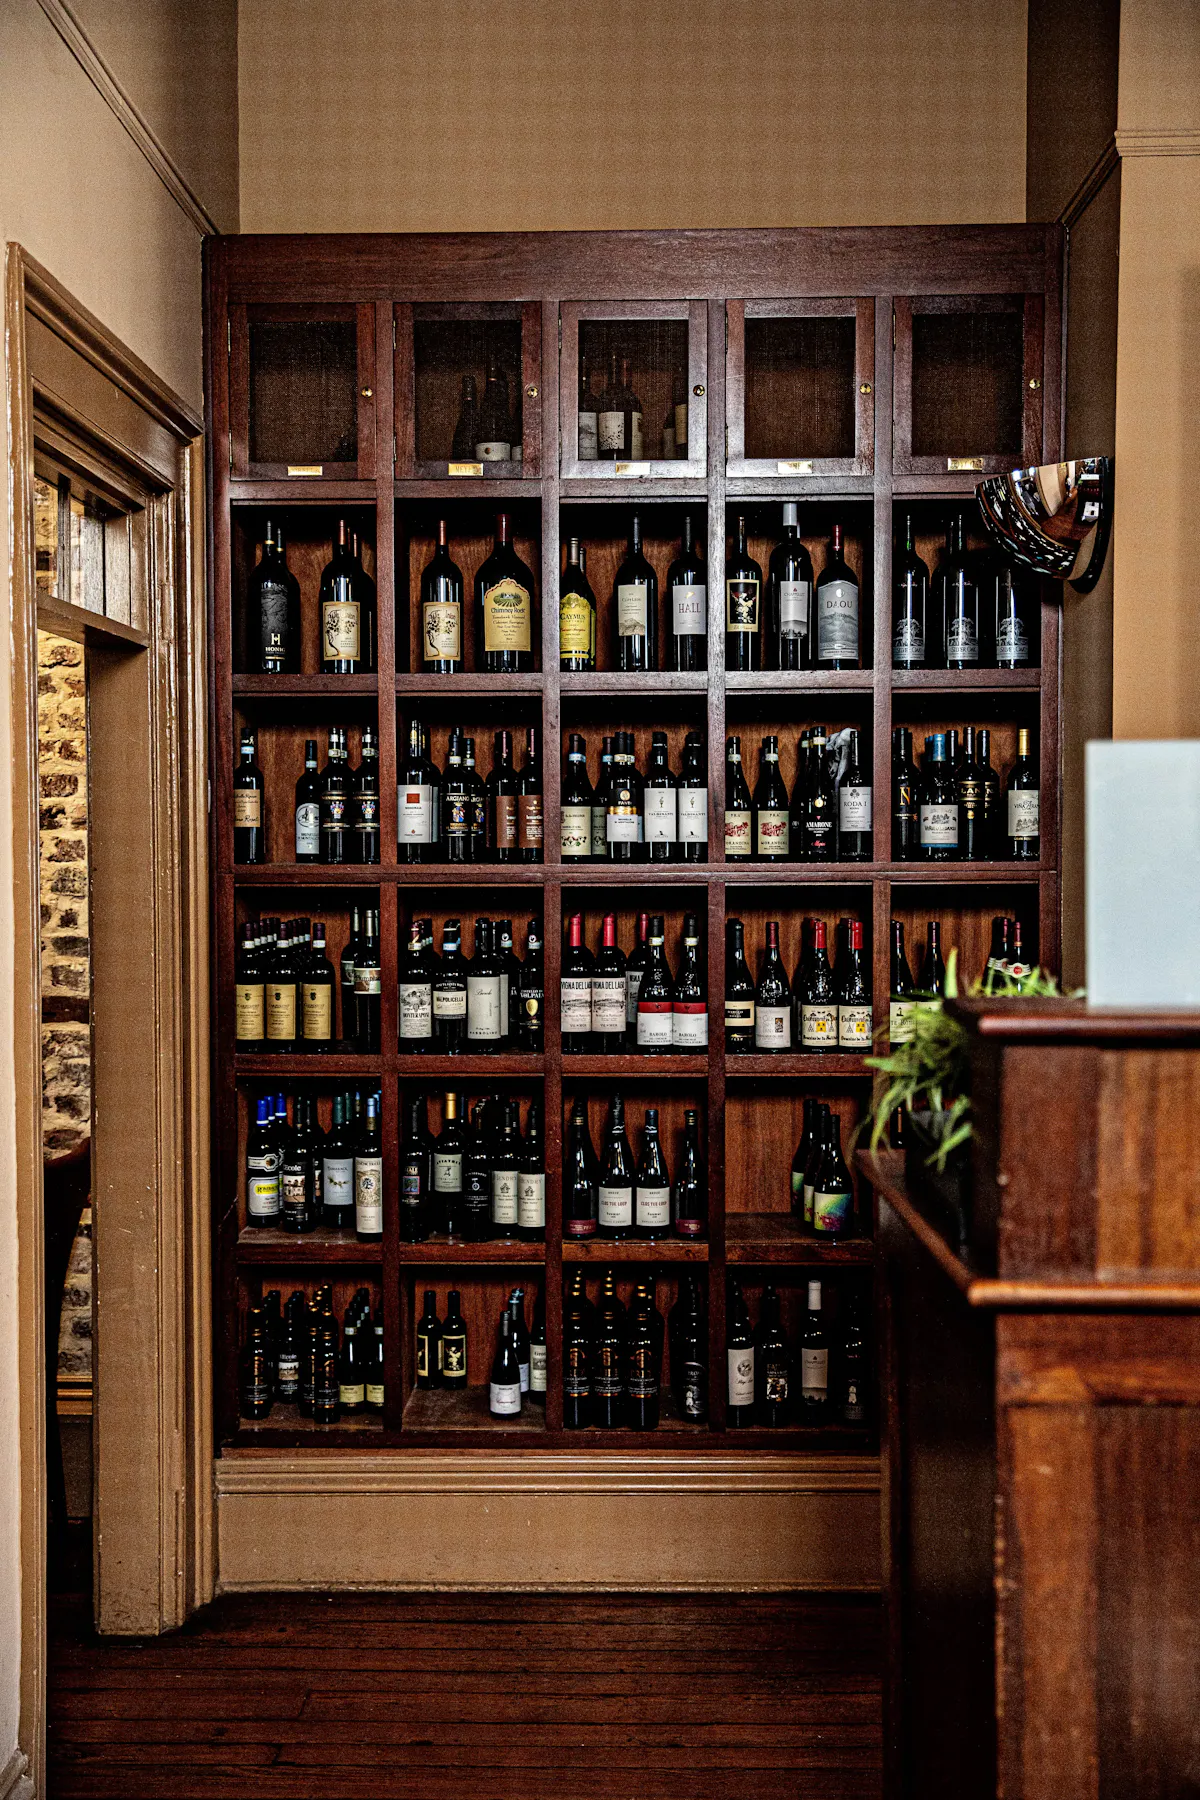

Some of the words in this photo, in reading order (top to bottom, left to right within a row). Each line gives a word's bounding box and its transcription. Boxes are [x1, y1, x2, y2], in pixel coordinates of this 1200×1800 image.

[678, 603, 702, 613] HALL
[826, 600, 853, 609] DAOU
[491, 606, 513, 614] Chimney
[560, 612, 586, 621] CAYMUS
[961, 787, 981, 795] LAN
